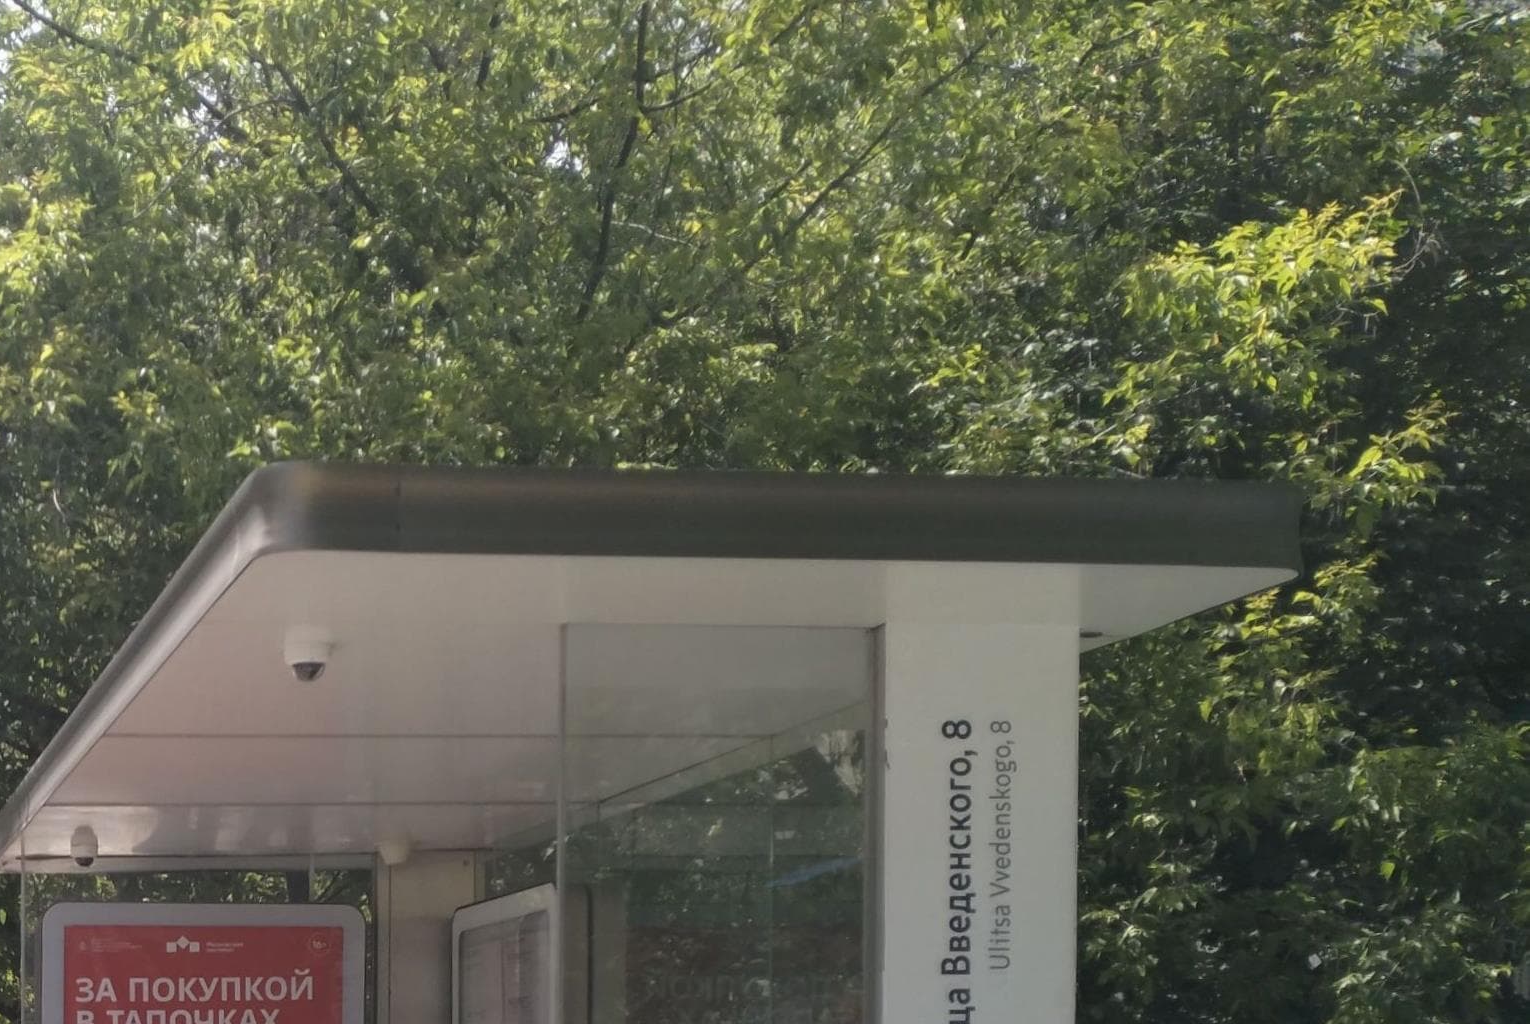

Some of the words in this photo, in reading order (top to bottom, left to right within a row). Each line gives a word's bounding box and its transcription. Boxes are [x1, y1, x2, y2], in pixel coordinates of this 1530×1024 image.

[942, 719, 973, 739] 8
[990, 719, 1012, 734] 8
[989, 740, 1016, 898] Vvedenskogo,
[941, 749, 978, 976] Введенского,
[988, 904, 1011, 970] Ulitsa
[75, 977, 117, 1003] ЗА
[128, 968, 314, 1002] ПОКУПКОЙ
